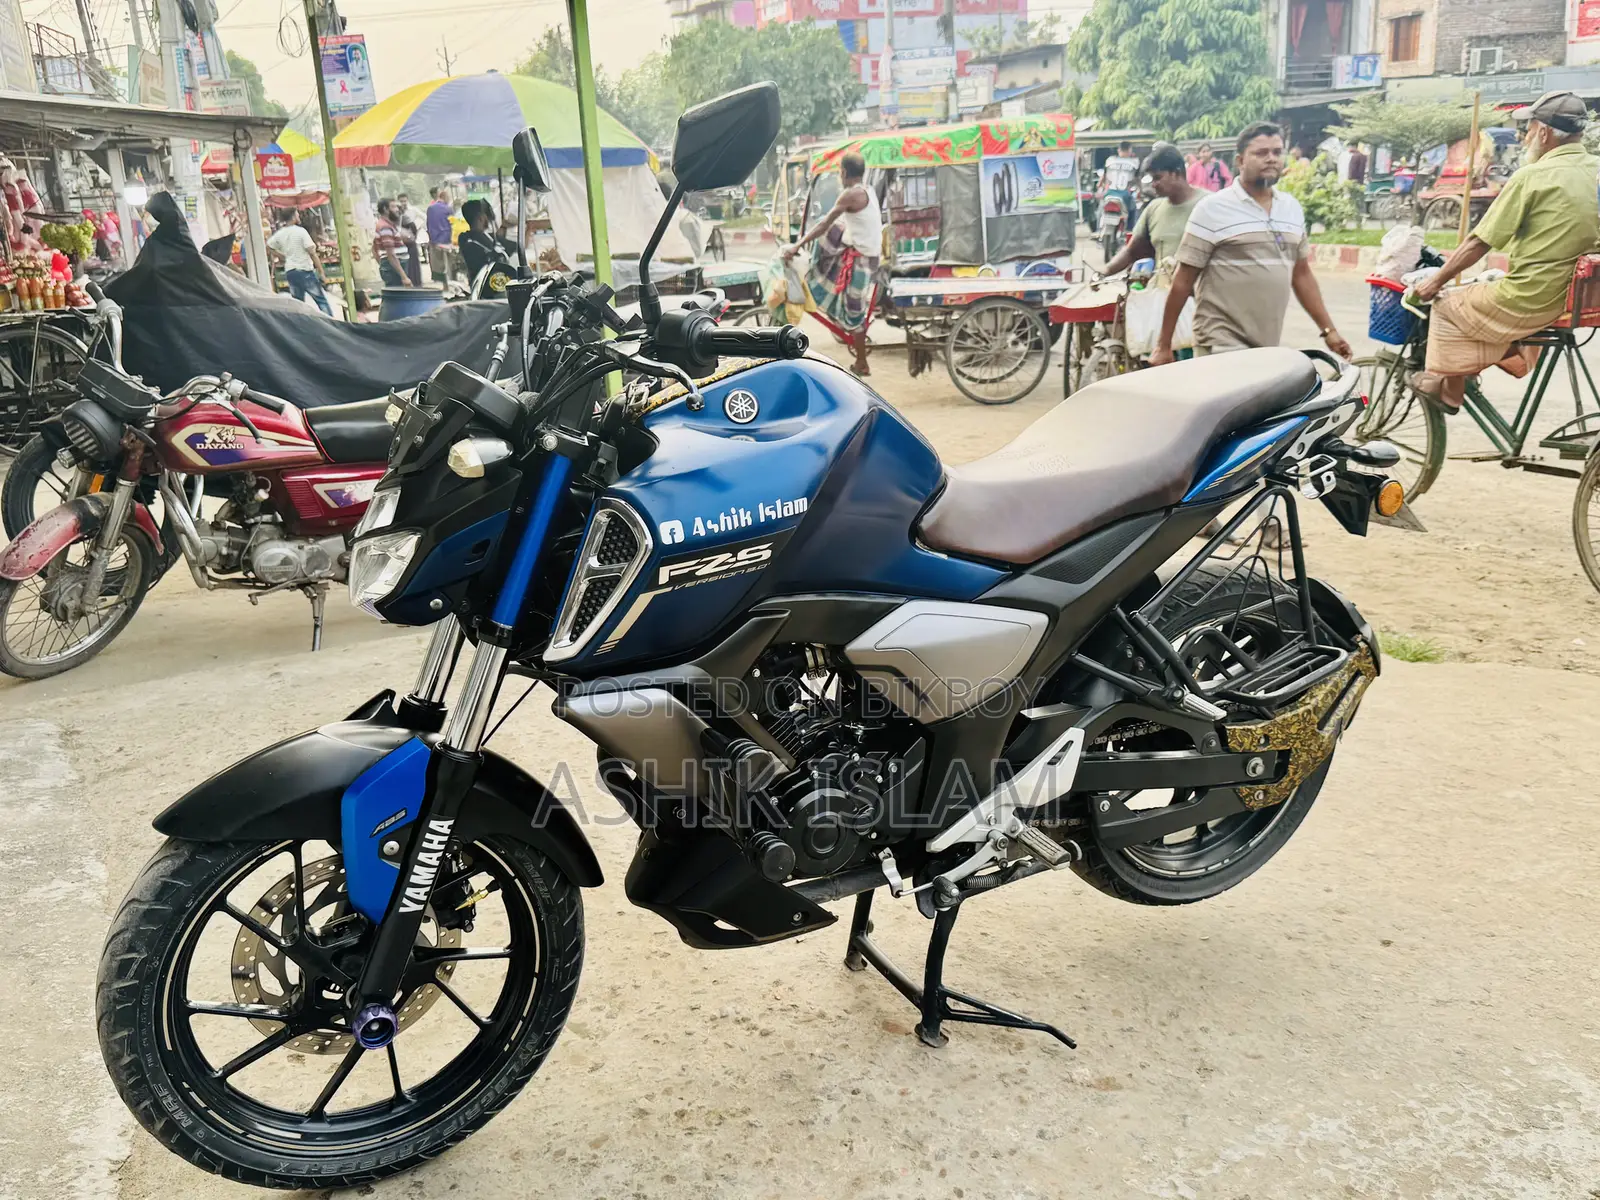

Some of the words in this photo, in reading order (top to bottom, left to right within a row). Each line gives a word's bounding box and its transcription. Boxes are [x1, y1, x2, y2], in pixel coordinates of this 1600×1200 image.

[692, 507, 753, 537] Ashik
[758, 497, 808, 523] Islam
[674, 570, 745, 590] VERSION
[398, 819, 455, 913] YAMAHA
[152, 1083, 193, 1128] MRF
